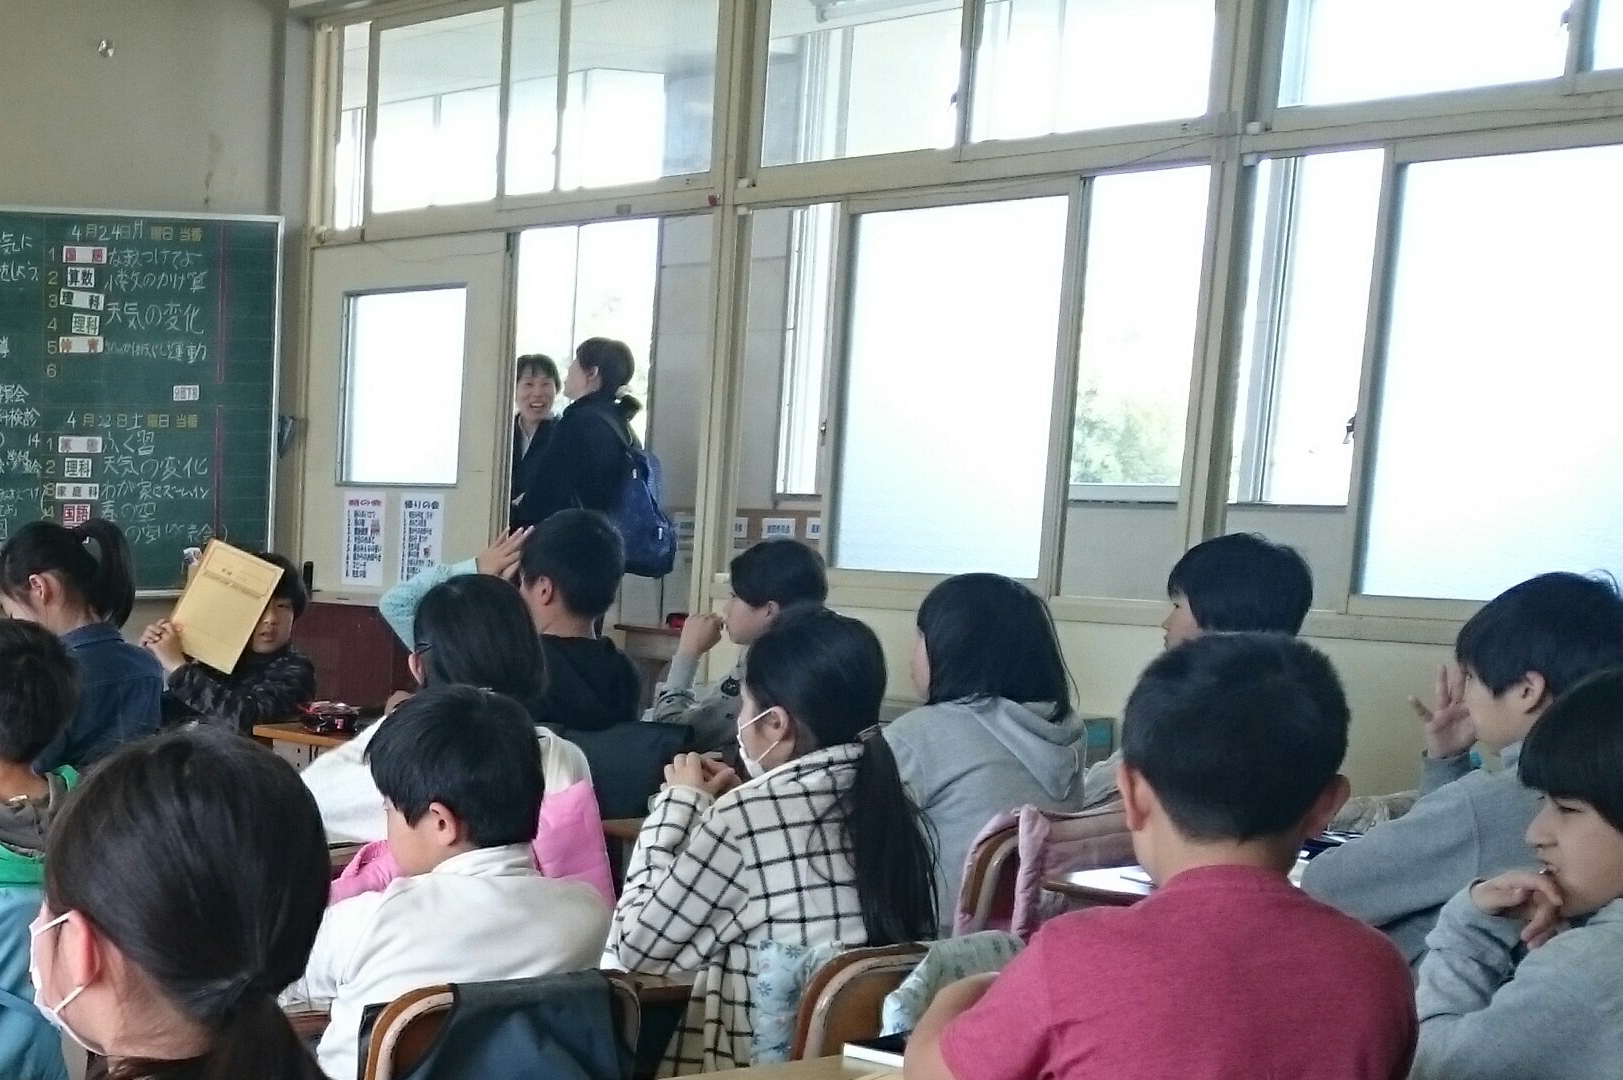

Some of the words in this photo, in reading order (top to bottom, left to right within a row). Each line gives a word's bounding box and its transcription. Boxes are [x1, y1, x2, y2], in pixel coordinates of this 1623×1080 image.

[68, 268, 94, 287] 算数
[72, 315, 97, 334] 理科
[105, 302, 205, 335] 天気の変化
[65, 459, 91, 477] 理科
[103, 455, 208, 481] 天気の変化
[64, 504, 90, 523] 国語
